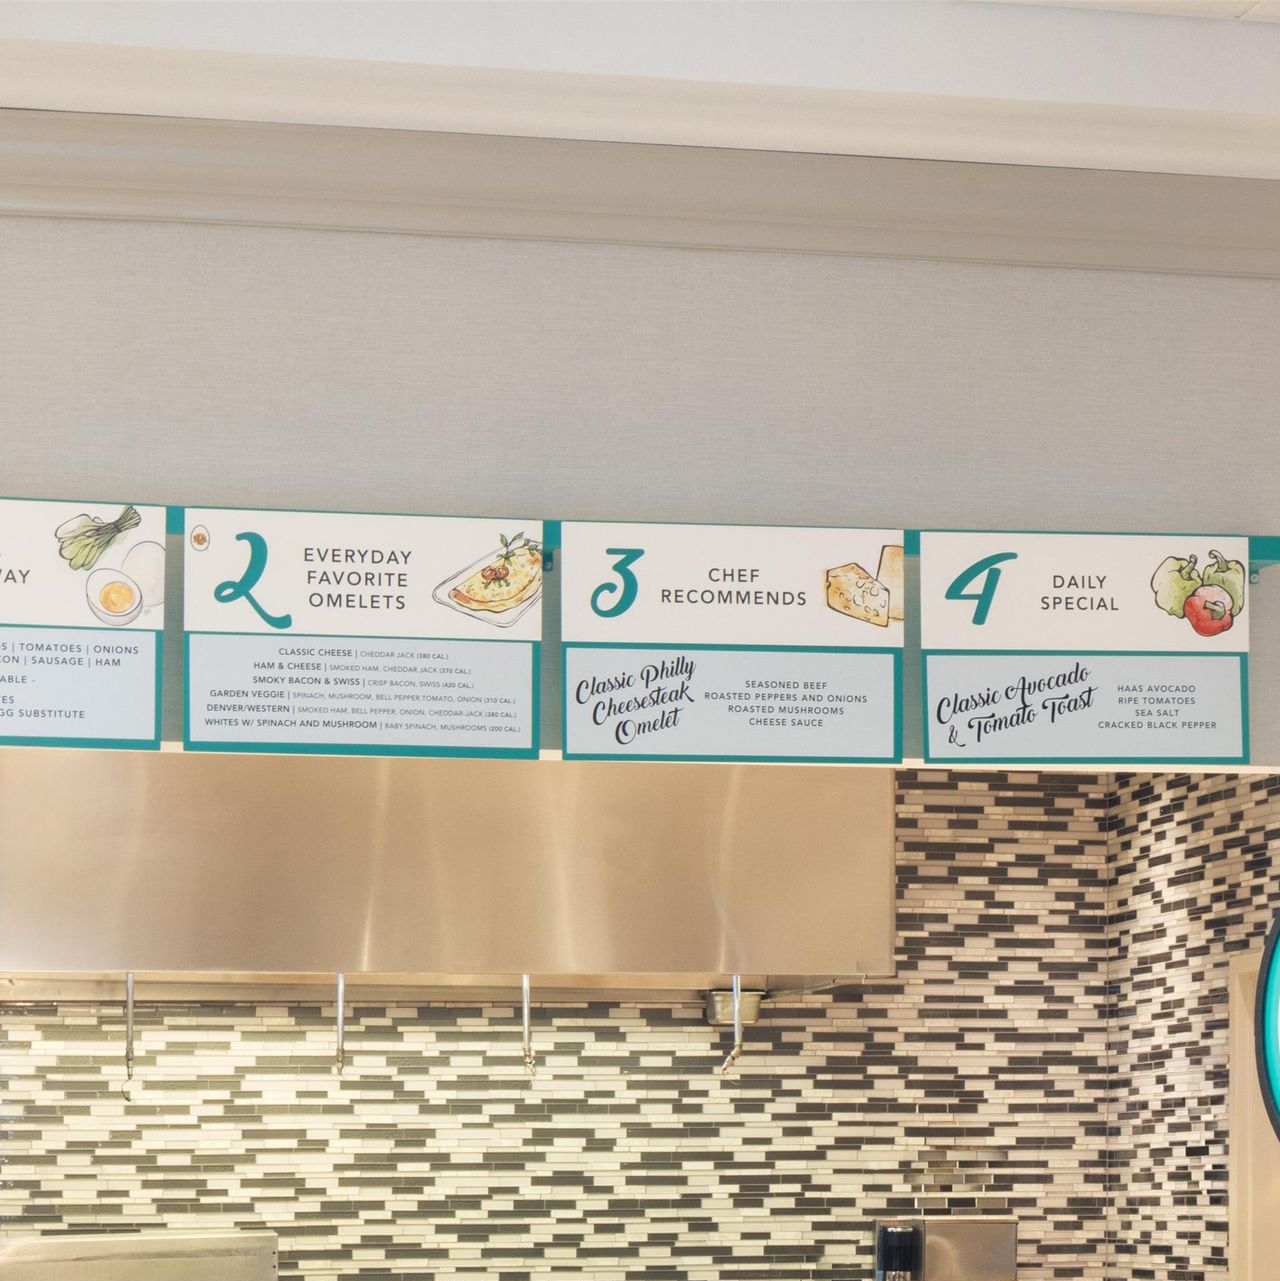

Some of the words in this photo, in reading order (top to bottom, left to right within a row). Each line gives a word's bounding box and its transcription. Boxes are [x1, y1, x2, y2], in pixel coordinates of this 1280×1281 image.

[304, 547, 412, 565] EVERYDAY
[214, 531, 292, 629] 2
[307, 570, 408, 588] FAVORITE
[708, 568, 760, 583] CHEF
[590, 548, 645, 618] 3
[1053, 575, 1107, 589] DAILY
[945, 552, 1018, 625] 4
[308, 592, 405, 610] OMELETS
[661, 589, 806, 606] RECOMMENDS
[1041, 596, 1119, 611] SPECIAL
[19, 642, 82, 653] TOMATOES
[93, 645, 139, 655] ONIONS
[278, 647, 316, 656] CLASSIC
[317, 648, 353, 657] CHEESE
[31, 655, 83, 666] SAUSAGE
[95, 658, 121, 667] HAM
[277, 662, 284, 670] &
[287, 662, 322, 671] CHEESE
[252, 675, 286, 684] SMOKY
[288, 676, 322, 685] BACON
[323, 677, 331, 685] &
[333, 677, 361, 686] SWISS
[576, 675, 636, 704] Classic
[640, 656, 696, 689] Philly
[745, 680, 800, 689] SEASONED
[803, 681, 827, 690] BEEF
[209, 689, 249, 698] GARDEN
[251, 690, 285, 699] VEGGIE
[936, 688, 1002, 724] Classic
[1005, 662, 1091, 706] Avocado
[1117, 684, 1144, 693] HAAS
[1146, 684, 1196, 693] AVOCADO
[704, 691, 751, 701] ROASTED
[755, 693, 798, 702] PEPPERS
[801, 694, 824, 702] AND
[827, 694, 867, 703] ONIONS
[1118, 696, 1139, 705] RIPE
[1142, 696, 1196, 705] TOMATOES
[206, 703, 290, 713] DENVER/WESTERN
[592, 681, 695, 726] Cheesesteak
[728, 704, 775, 714] ROASTED
[778, 706, 844, 715] MUSHROOMS
[18, 708, 85, 719] SUBSTITUTE
[948, 724, 966, 747] &
[967, 704, 1038, 743] Tomato
[1041, 686, 1098, 723] Toast
[1135, 709, 1153, 717] SEA
[1156, 709, 1180, 717] SALT
[204, 718, 239, 727] WHITES
[256, 718, 297, 727] SPINACH
[299, 719, 320, 728] AND
[322, 720, 377, 729] MUSHROOM
[615, 707, 684, 745] Omelet
[748, 717, 787, 727] CHEESE
[790, 718, 823, 727] SAUCE
[1098, 721, 1144, 729] CRACKED
[1147, 721, 1178, 729] BLACK
[1181, 721, 1217, 729] PEPPER
